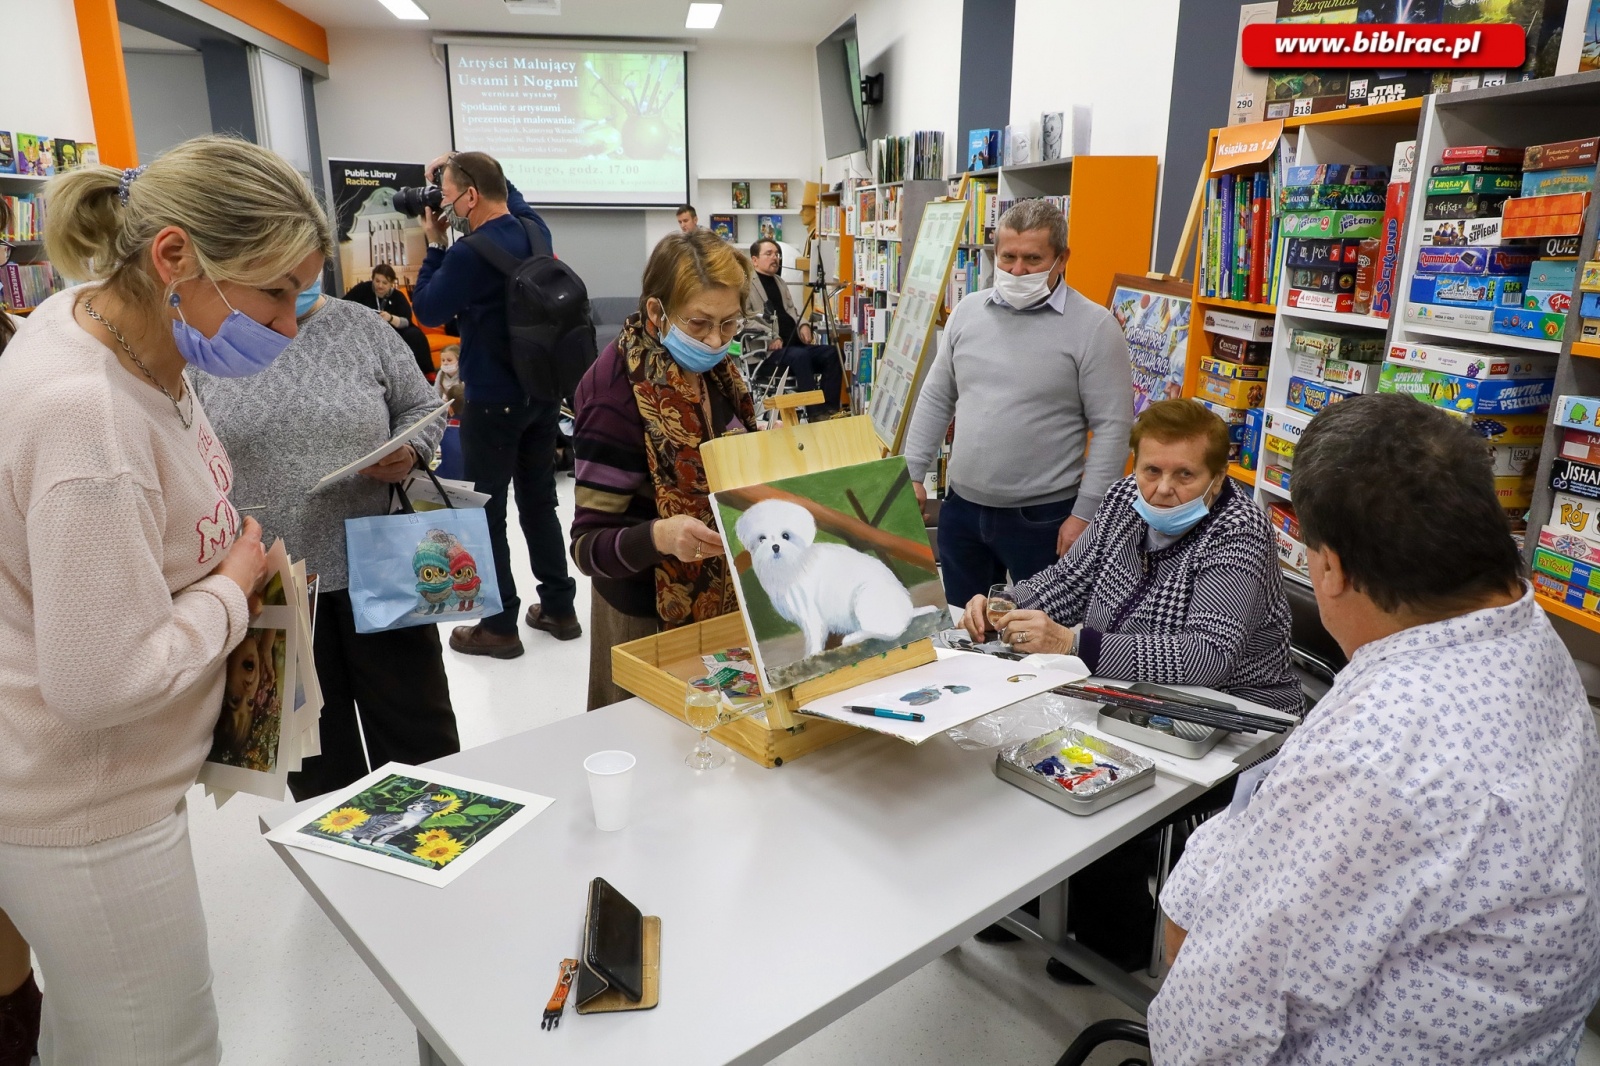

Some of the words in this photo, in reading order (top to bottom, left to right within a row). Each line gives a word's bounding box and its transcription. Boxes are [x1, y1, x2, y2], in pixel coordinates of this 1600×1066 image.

[458, 57, 508, 72] Artyści
[514, 57, 576, 73] Malujący
[458, 74, 508, 86] Ustami
[514, 75, 518, 86] i
[523, 75, 578, 90] Nogami
[481, 90, 519, 98] wernisaż
[522, 92, 558, 100] wystawy
[1350, 88, 1366, 98] 532
[1368, 84, 1406, 97] STAR
[461, 102, 507, 113] Spotkanie
[518, 103, 561, 114] artystami
[1237, 100, 1253, 109] 290
[1293, 105, 1311, 115] 318
[468, 115, 521, 125] prezentacja
[523, 116, 576, 125] malowania:
[1218, 142, 1247, 156] Książka
[1248, 142, 1258, 152] za
[1261, 139, 1267, 150] 1
[344, 169, 369, 178] Public
[370, 170, 397, 180] Library
[519, 164, 564, 175] lutego,
[569, 164, 603, 175] godz.
[608, 165, 639, 174] 17.00
[345, 177, 380, 186] Raciborz
[1339, 216, 1377, 234] jestem?
[1471, 223, 1485, 231] MAMY
[1468, 222, 1499, 242] SZPIEGA!
[1546, 238, 1579, 256] QUIZ
[1420, 252, 1460, 268] Rummikub
[9, 265, 21, 303] ZWIERZĘTA
[1372, 292, 1392, 312] 5
[1219, 339, 1239, 350] CENTURY
[1394, 372, 1425, 382] SPRYTNE
[1497, 383, 1544, 400] SPRYTNE
